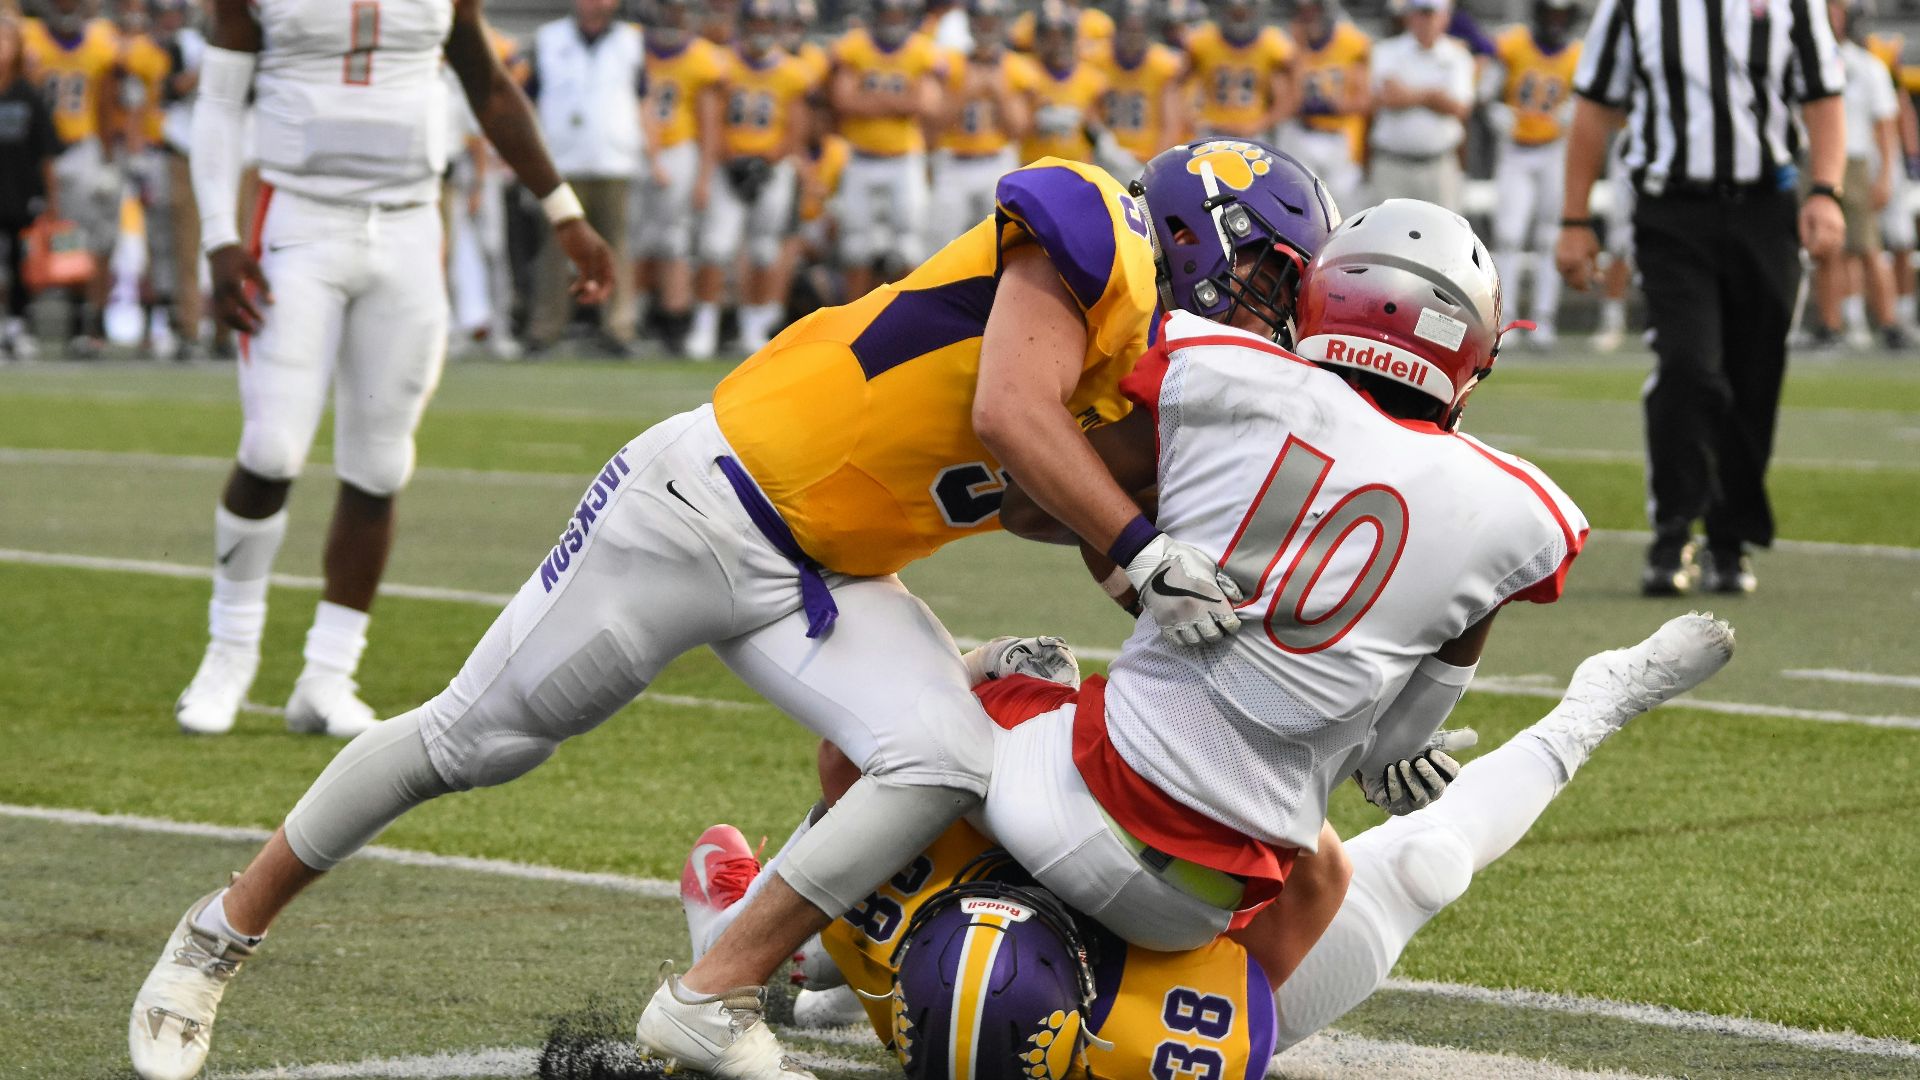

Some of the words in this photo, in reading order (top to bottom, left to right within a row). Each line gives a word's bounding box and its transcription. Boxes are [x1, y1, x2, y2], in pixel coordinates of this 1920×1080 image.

[342, 0, 382, 86] 1
[1325, 338, 1429, 386] Riddell
[540, 447, 631, 593] JACKSON
[1217, 432, 1410, 655] 10
[967, 901, 1021, 917] Riddell
[1149, 985, 1236, 1080] 38
